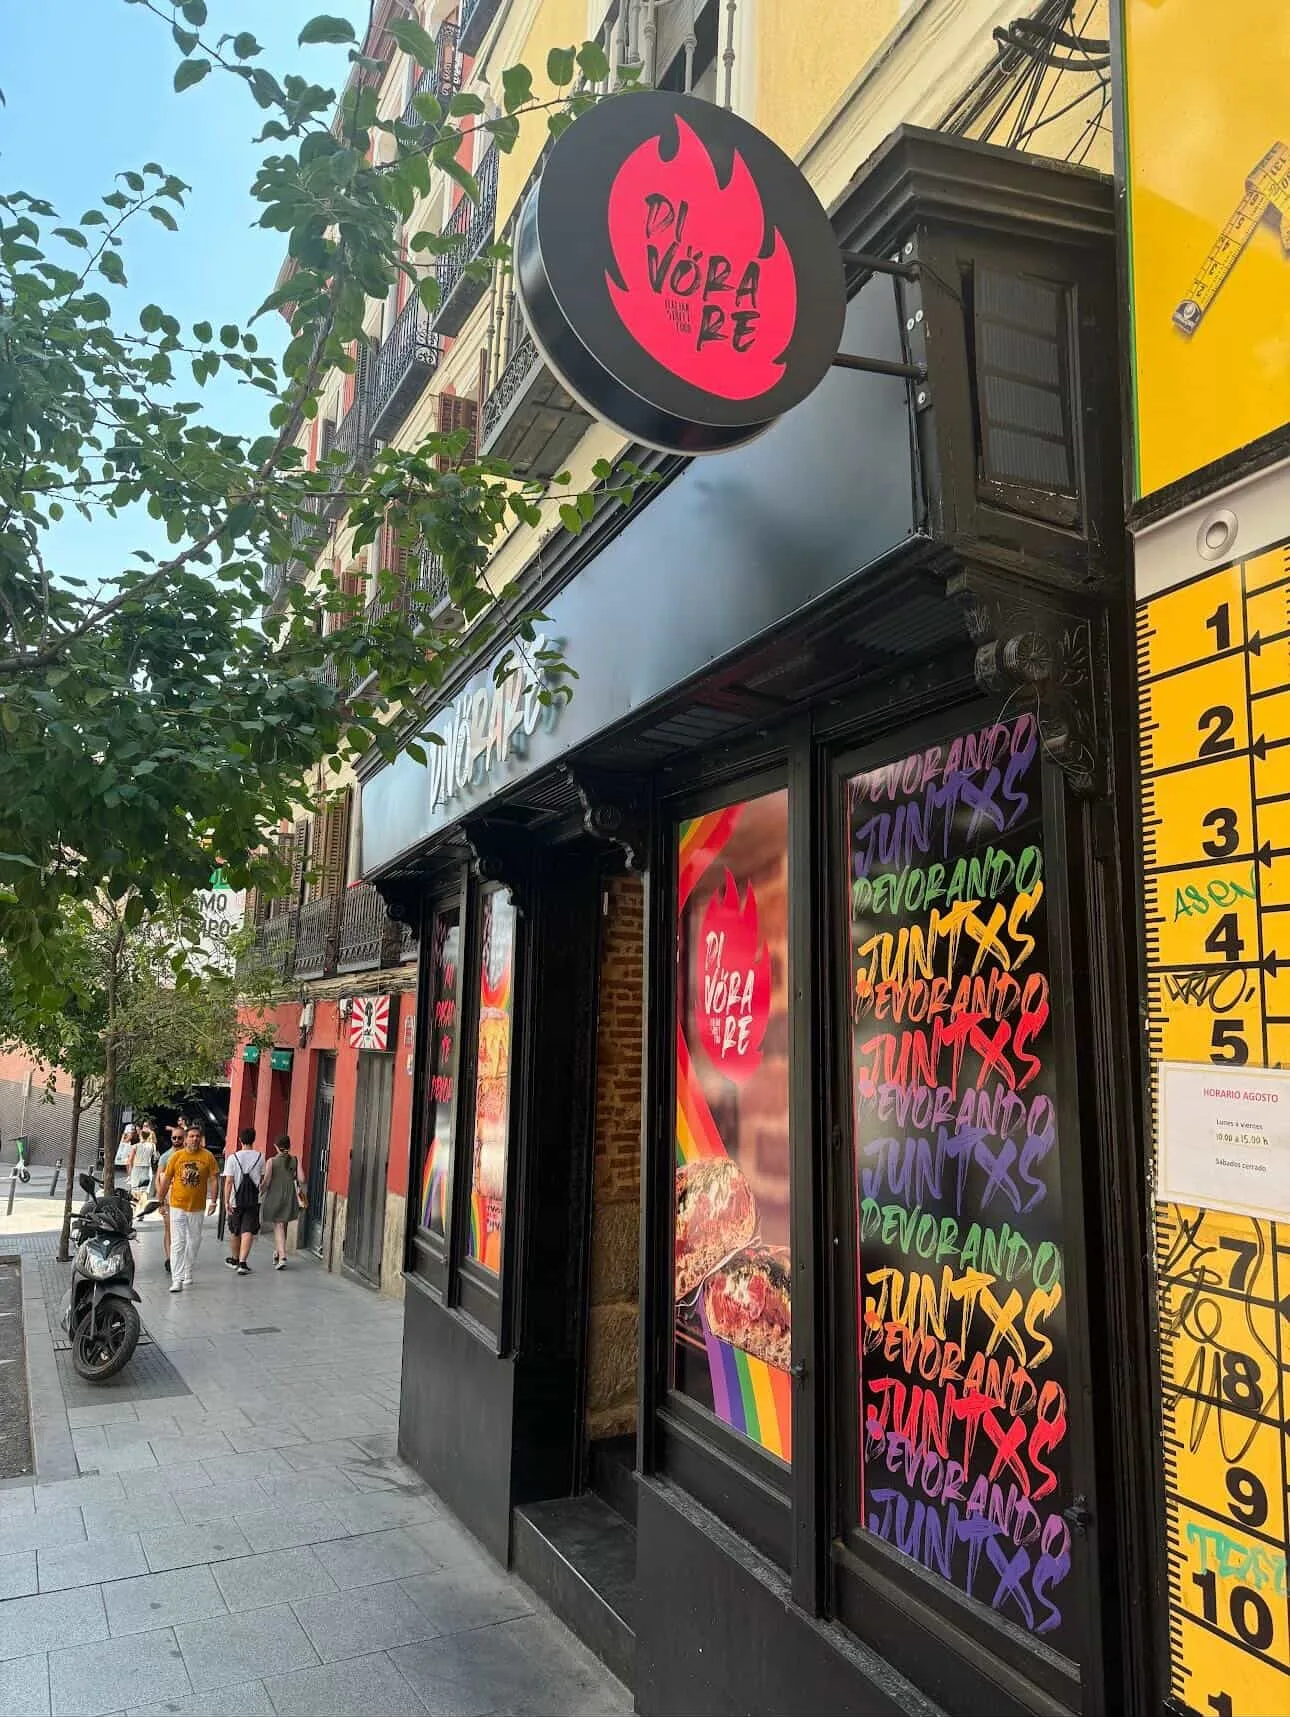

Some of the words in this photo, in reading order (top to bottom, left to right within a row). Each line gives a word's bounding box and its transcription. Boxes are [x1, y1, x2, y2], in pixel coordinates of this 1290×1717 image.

[644, 193, 689, 243] DI
[696, 305, 760, 353] RE
[1206, 603, 1231, 651] 1
[1198, 705, 1235, 758] 2
[849, 712, 1037, 812] DEVORANDO
[854, 740, 1037, 877] JUNTXS
[1203, 807, 1240, 858] 3
[853, 846, 1042, 919] DEVORANDO
[705, 931, 725, 971] DI
[855, 880, 1043, 999] JUNTXS
[1205, 912, 1244, 961] 4
[854, 967, 1048, 1023] DEVORANDO
[721, 1015, 752, 1059] RE
[859, 1001, 1049, 1100] JUNTXS
[1210, 1019, 1249, 1066] 5
[858, 1083, 1055, 1140] DEVORANDO
[1203, 1088, 1240, 1100] HORARIO
[1242, 1091, 1279, 1103] AGOSTO
[861, 1124, 1055, 1214] JUNTXS
[861, 1198, 1061, 1292] DEVORANDO
[1219, 1236, 1258, 1291] 7
[864, 1265, 1061, 1369] JUNTXS
[864, 1310, 1066, 1418] DEVORANDO
[1222, 1350, 1263, 1410] 8
[867, 1375, 1066, 1499] JUNTXS
[866, 1419, 1070, 1556] DEVORANDO
[1225, 1467, 1268, 1527] 9
[868, 1488, 1070, 1634] JUNTXS
[1192, 1569, 1273, 1650] 10
